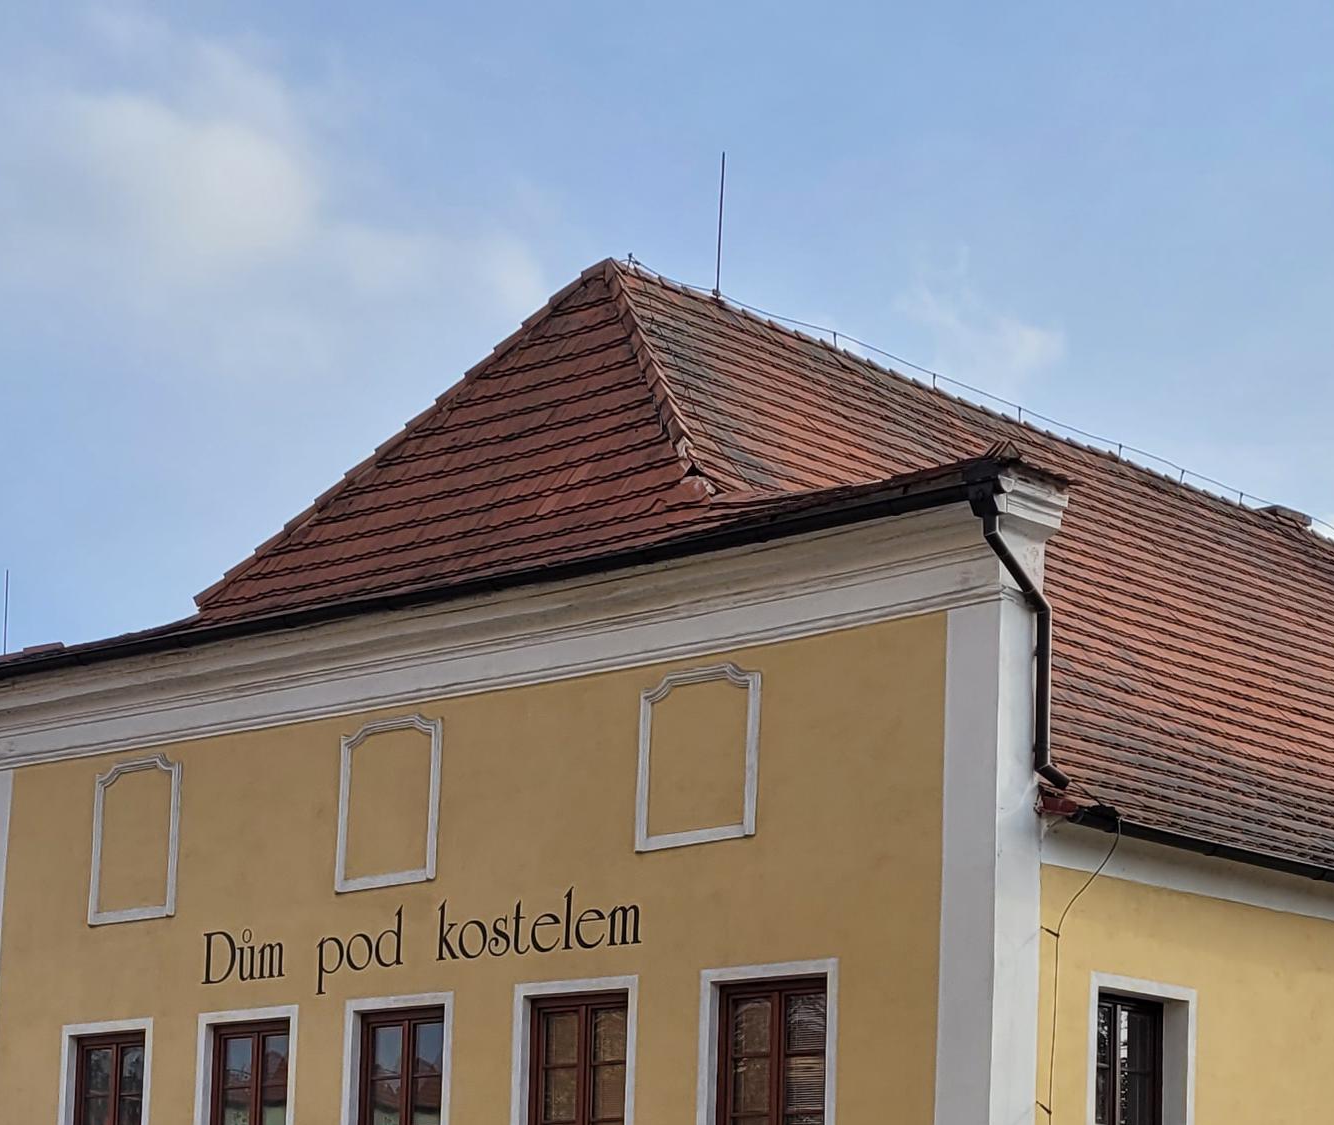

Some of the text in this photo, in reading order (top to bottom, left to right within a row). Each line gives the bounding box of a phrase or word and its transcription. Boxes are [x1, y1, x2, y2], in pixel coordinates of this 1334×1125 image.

[201, 886, 642, 996] Dům pod kostelem
